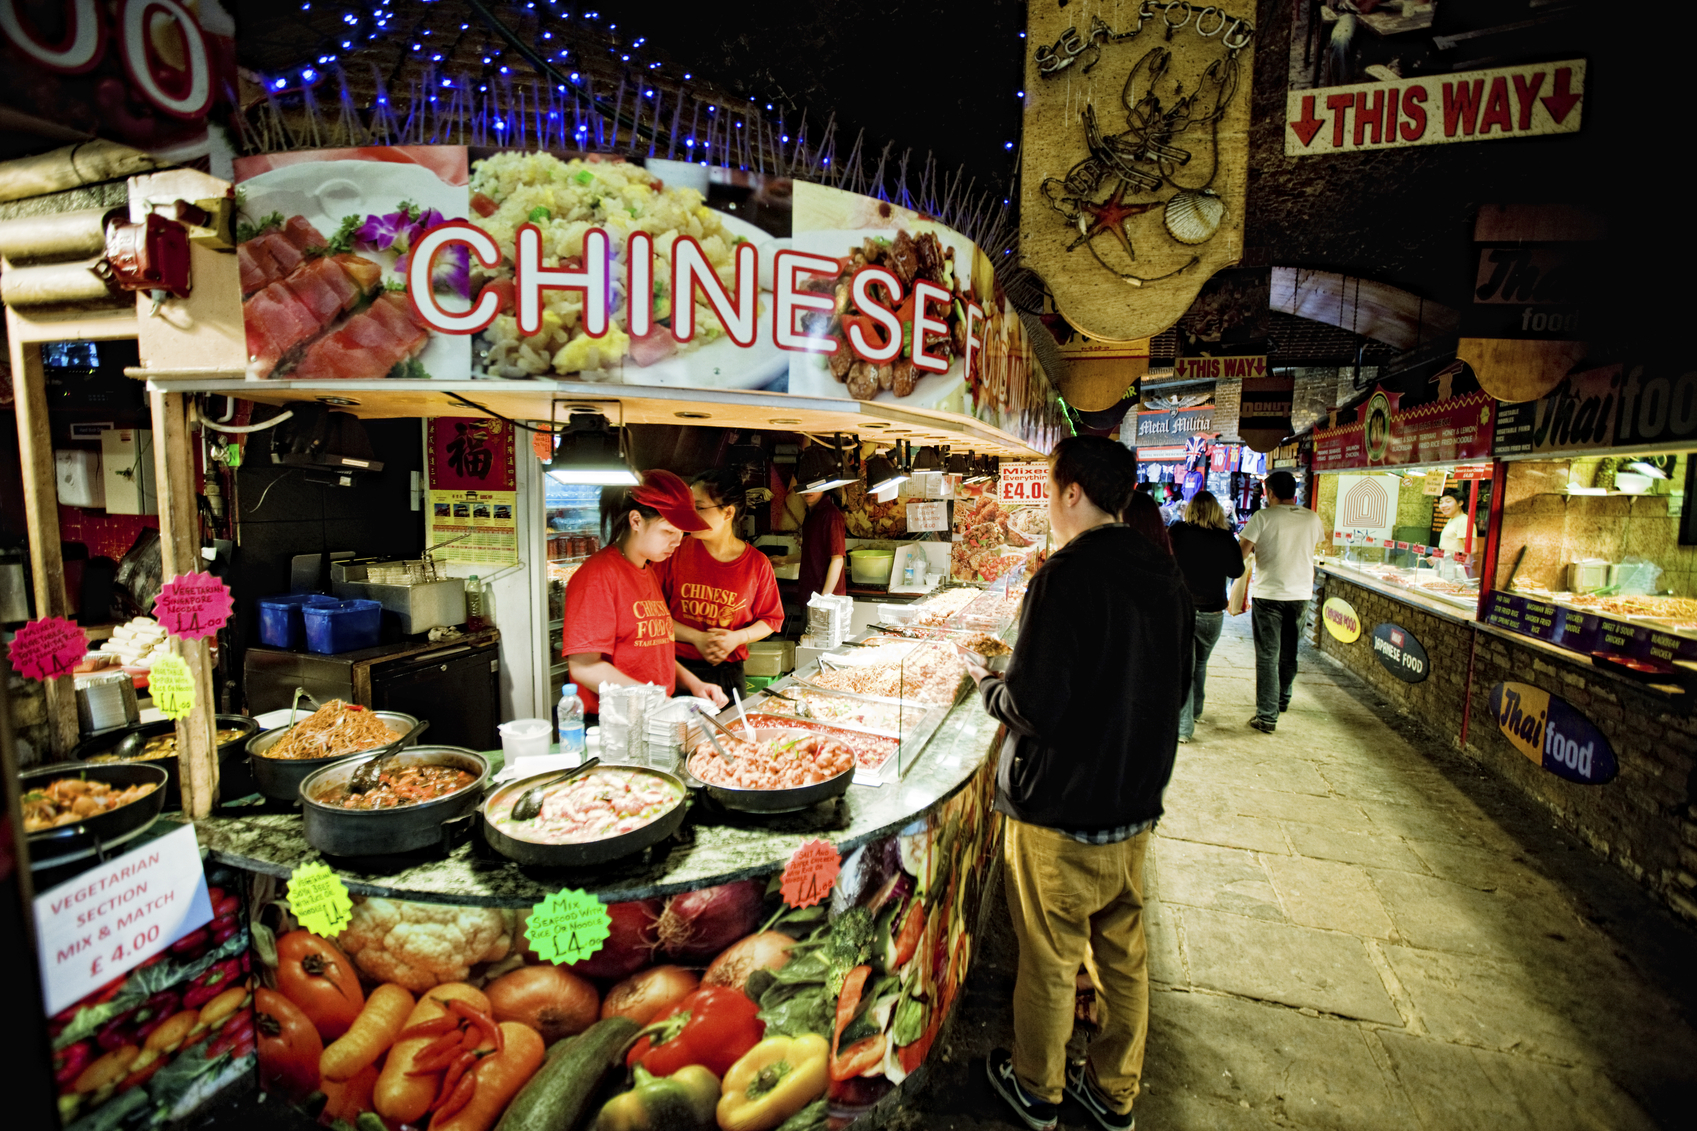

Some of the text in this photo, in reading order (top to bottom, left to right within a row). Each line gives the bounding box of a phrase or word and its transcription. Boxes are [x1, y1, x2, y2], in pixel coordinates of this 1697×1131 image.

[1138, 0, 1254, 49] FOOD
[1327, 72, 1546, 147] THIS WAY
[407, 221, 952, 375] CHINESE
[963, 302, 1008, 404] FOOD
[1521, 307, 1580, 331] food
[1188, 358, 1256, 378] THIS WAY
[1242, 401, 1291, 418] DONUT
[1138, 415, 1211, 436] Metal Militia
[446, 418, 493, 481] 福
[1214, 453, 1224, 467] 10
[1248, 453, 1254, 465] 7
[162, 595, 213, 606] SINGAPORE
[172, 584, 224, 595] VEGETARIAN
[681, 583, 738, 607] CHINESE
[167, 604, 204, 613] NOODLE
[681, 600, 718, 619] FOOD
[1601, 621, 1616, 632] SWEET
[1620, 626, 1635, 637] SOUR
[1605, 634, 1625, 646] CHICKEN
[1374, 635, 1401, 662] JAPANESE
[1402, 653, 1423, 674] FOOD
[1650, 646, 1673, 660] CHICKEN
[1500, 687, 1594, 779] Thai food
[799, 850, 814, 860] SALT
[51, 852, 160, 916] VEGETARIAN
[77, 882, 148, 928] SECTION
[553, 899, 580, 913] MIX
[56, 890, 174, 964] MIX & MATCH
[530, 918, 603, 940] RICE OR NOODLE
[532, 907, 603, 929] SEAFOOD WITH
[90, 924, 160, 977] £ 4.00
[553, 931, 603, 958] £4.00
